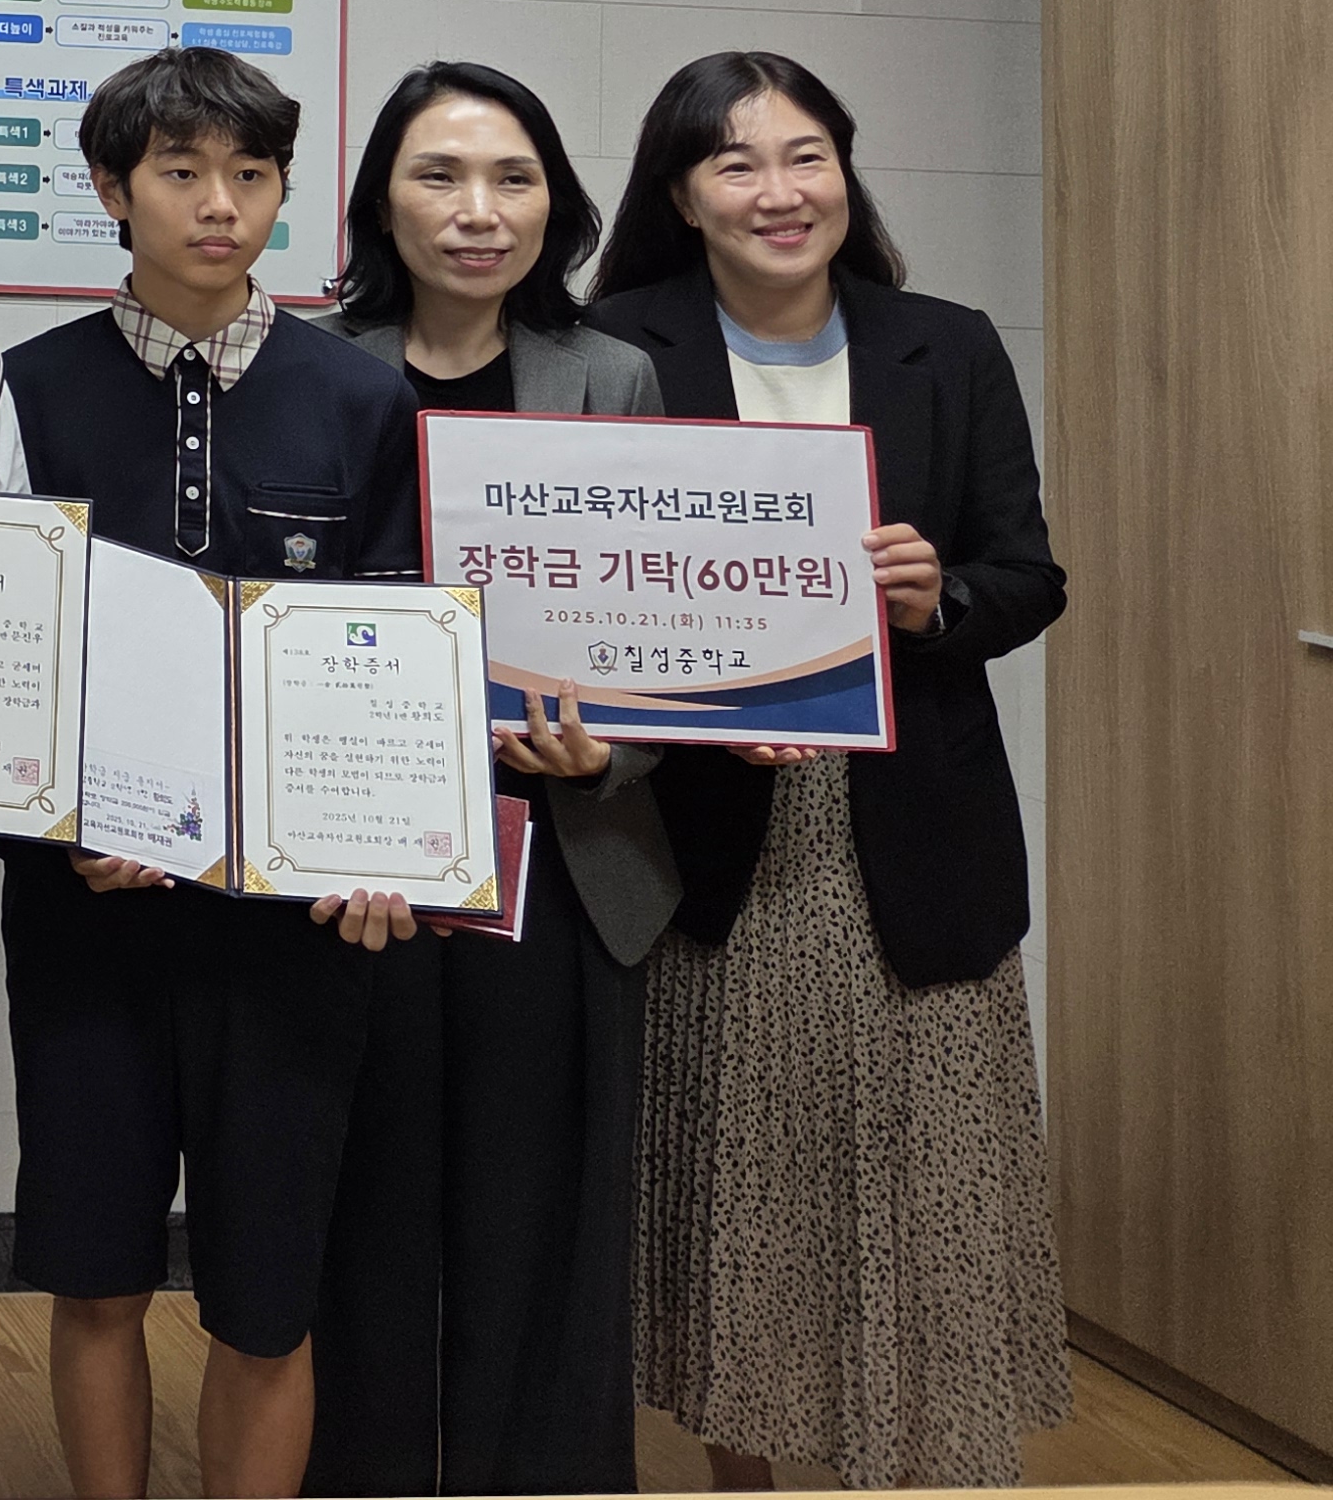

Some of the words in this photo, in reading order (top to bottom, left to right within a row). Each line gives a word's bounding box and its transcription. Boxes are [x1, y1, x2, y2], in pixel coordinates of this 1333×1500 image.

[0, 22, 32, 36] 더높이
[5, 77, 87, 100] 특색과제
[485, 481, 815, 527] 마산교육자선교원로회
[458, 543, 581, 589] 장학금
[600, 550, 850, 606] 기탁(60만원)
[544, 609, 704, 631] 2025.10.21.(화)
[716, 615, 768, 631] 11:35
[321, 655, 399, 675] 장학증서
[624, 645, 751, 674] 칠성중학교
